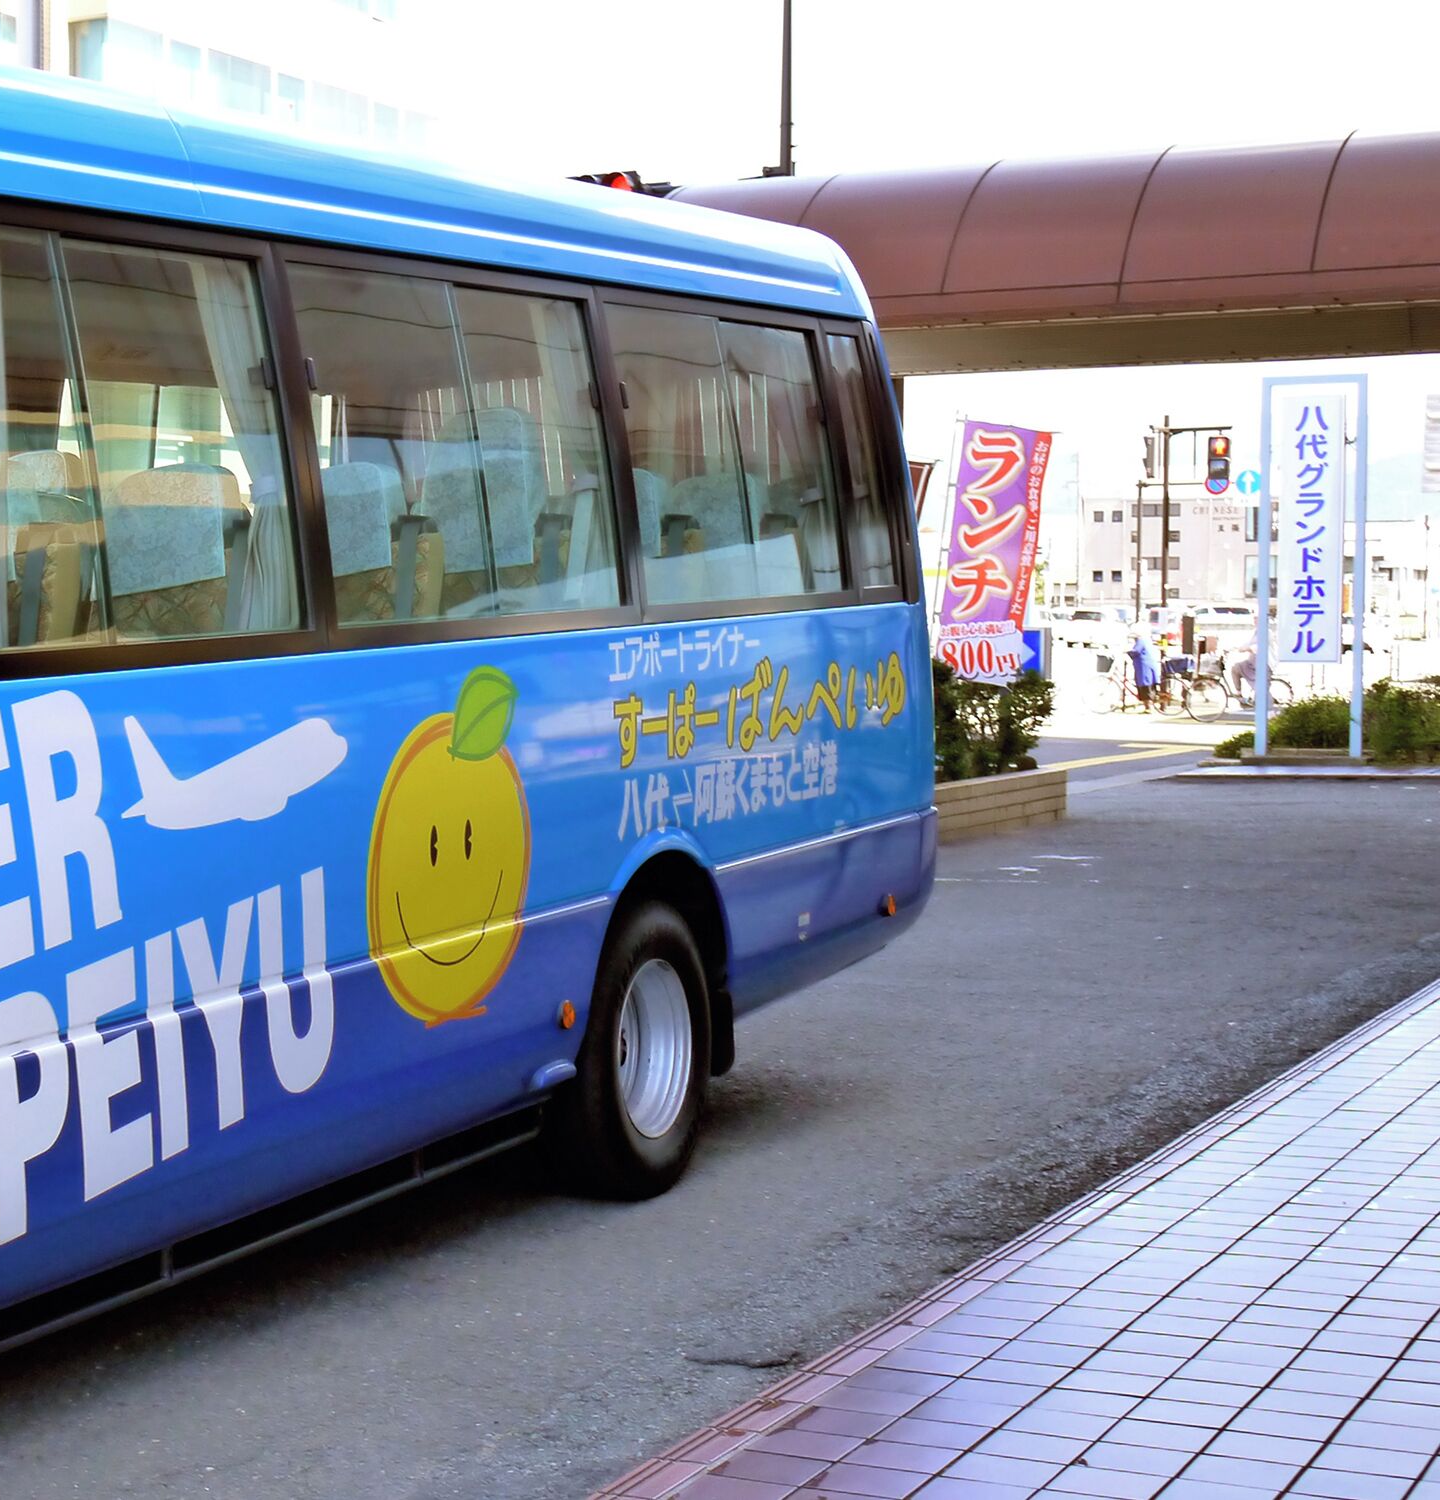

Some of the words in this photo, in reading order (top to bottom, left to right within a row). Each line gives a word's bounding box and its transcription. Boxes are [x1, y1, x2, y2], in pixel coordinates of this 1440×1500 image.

[948, 429, 1027, 620] ランチ
[1292, 405, 1329, 654] 八代グランドホテル
[609, 626, 760, 682] エアポートライナー
[942, 639, 1018, 675] 800円
